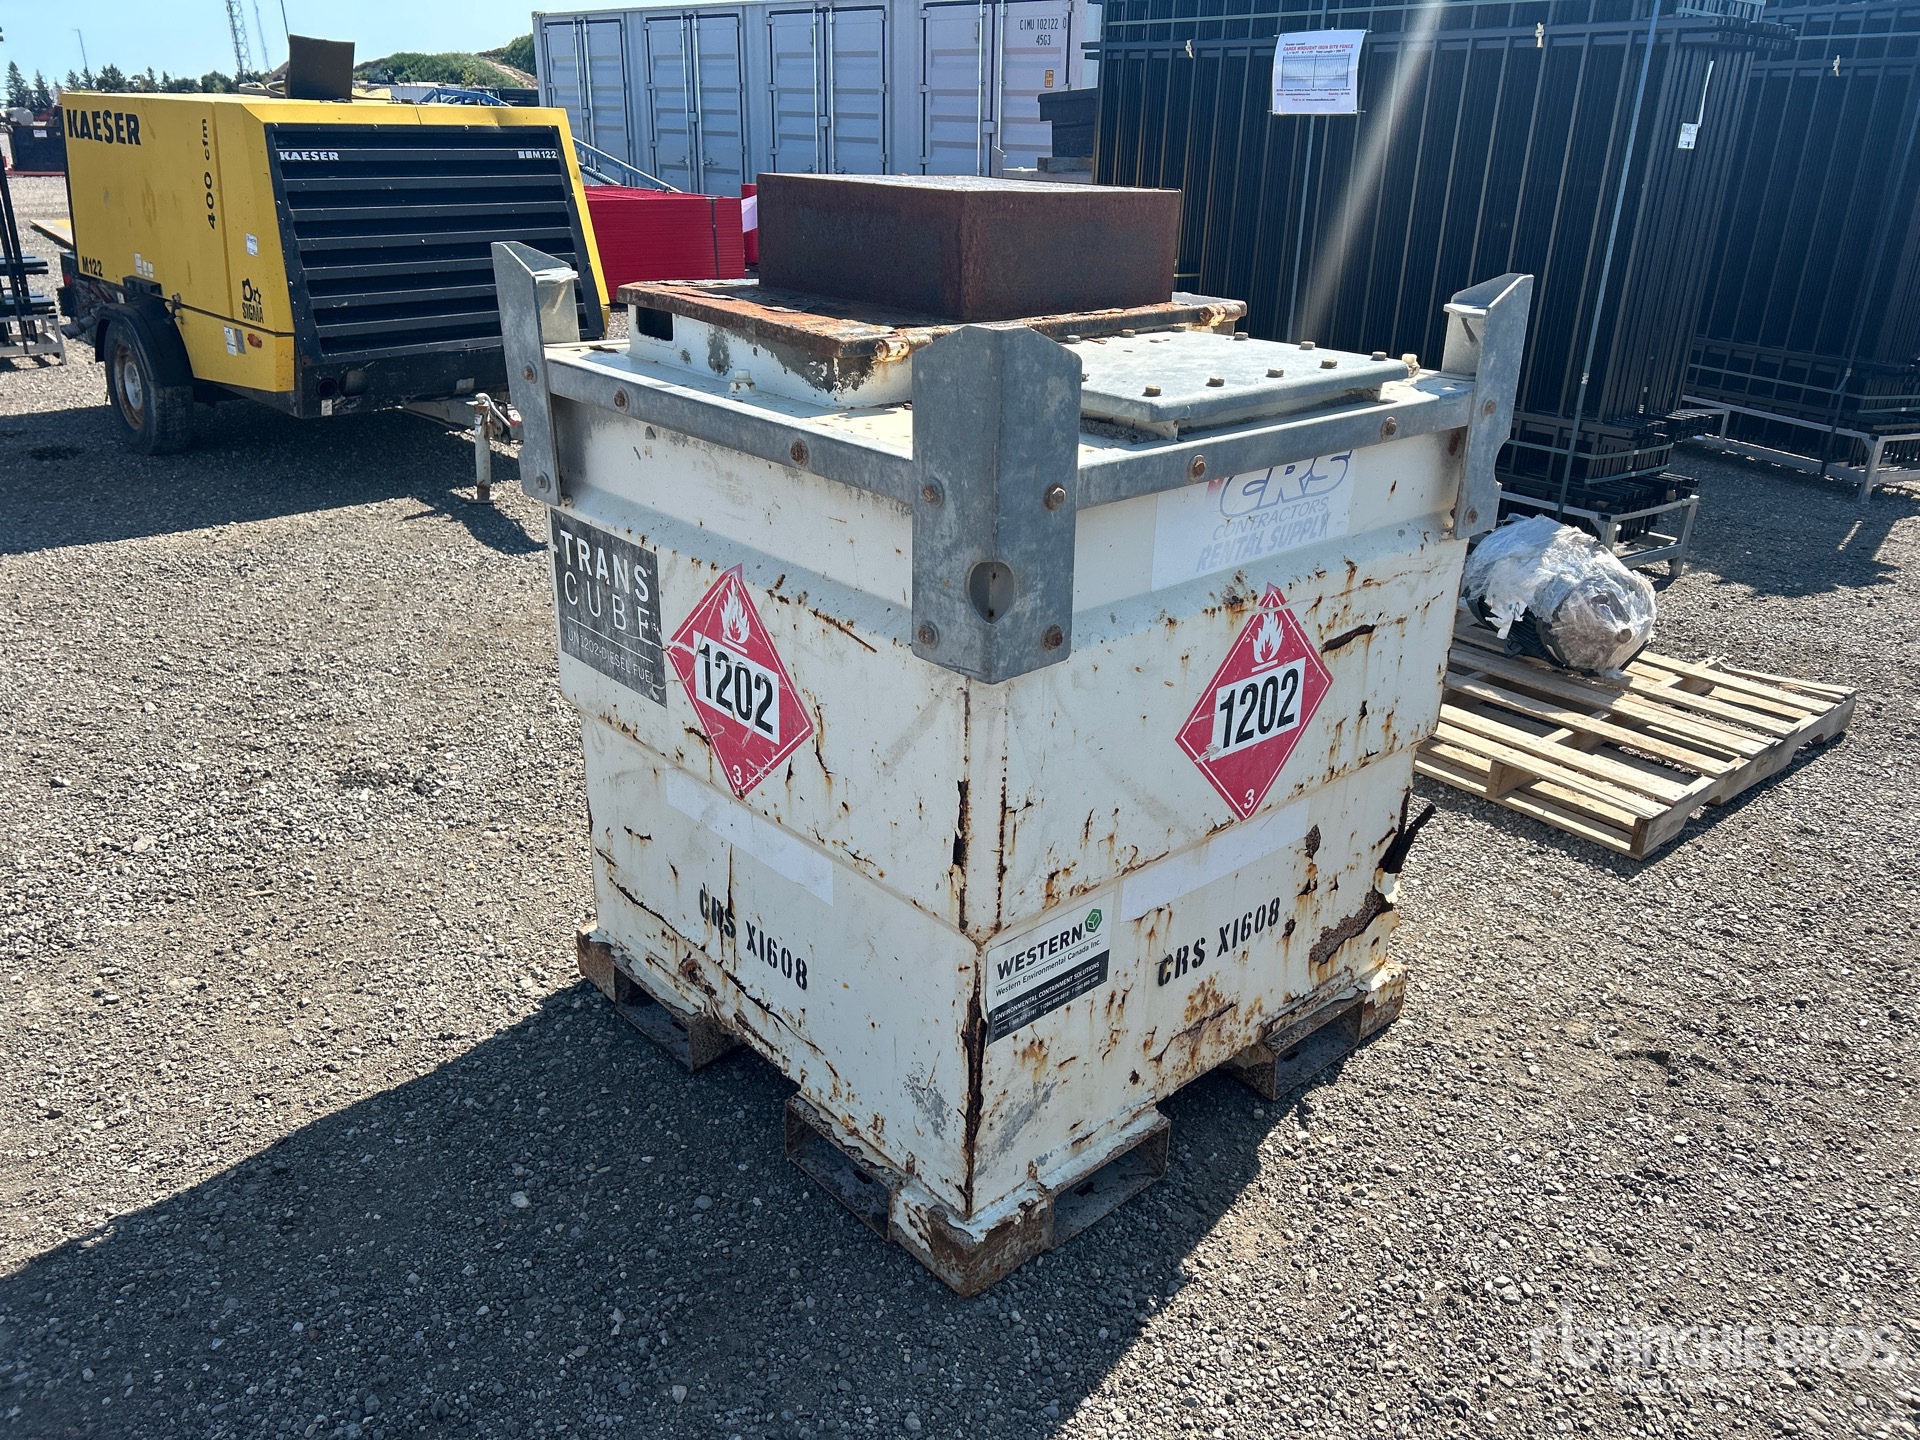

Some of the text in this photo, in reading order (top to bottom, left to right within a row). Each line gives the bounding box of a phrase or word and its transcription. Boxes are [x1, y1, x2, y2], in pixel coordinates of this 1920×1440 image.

[1020, 19, 1034, 30] CIMU
[1037, 18, 1058, 29] 102122
[1036, 35, 1051, 46] 45G3
[66, 109, 142, 146] KAESER
[532, 150, 558, 159] M122
[202, 119, 216, 230] 400 cfm
[280, 151, 339, 161] KAESER
[82, 256, 103, 277] M122
[242, 302, 264, 324] SIGMA
[1220, 450, 1353, 518] CRS
[1196, 511, 1331, 573] RENTAL SUPPLY
[1212, 497, 1329, 540] CONTRACTORS
[560, 529, 649, 603] TRANS
[564, 571, 654, 646] CUBE
[699, 643, 773, 735] 1202
[1220, 668, 1299, 749] 1202
[732, 764, 742, 785] 3
[1243, 788, 1255, 809] 3
[700, 883, 807, 990] CRS X1608
[997, 923, 1083, 980] WESTERN
[1158, 897, 1280, 986] CRS X1608
[995, 980, 1021, 997] Western
[1022, 955, 1067, 984] Environmental
[1067, 945, 1090, 961] Canada
[995, 962, 1100, 1021] ENVIRONMENTAL CONTAINMENT SOLUTIONS
